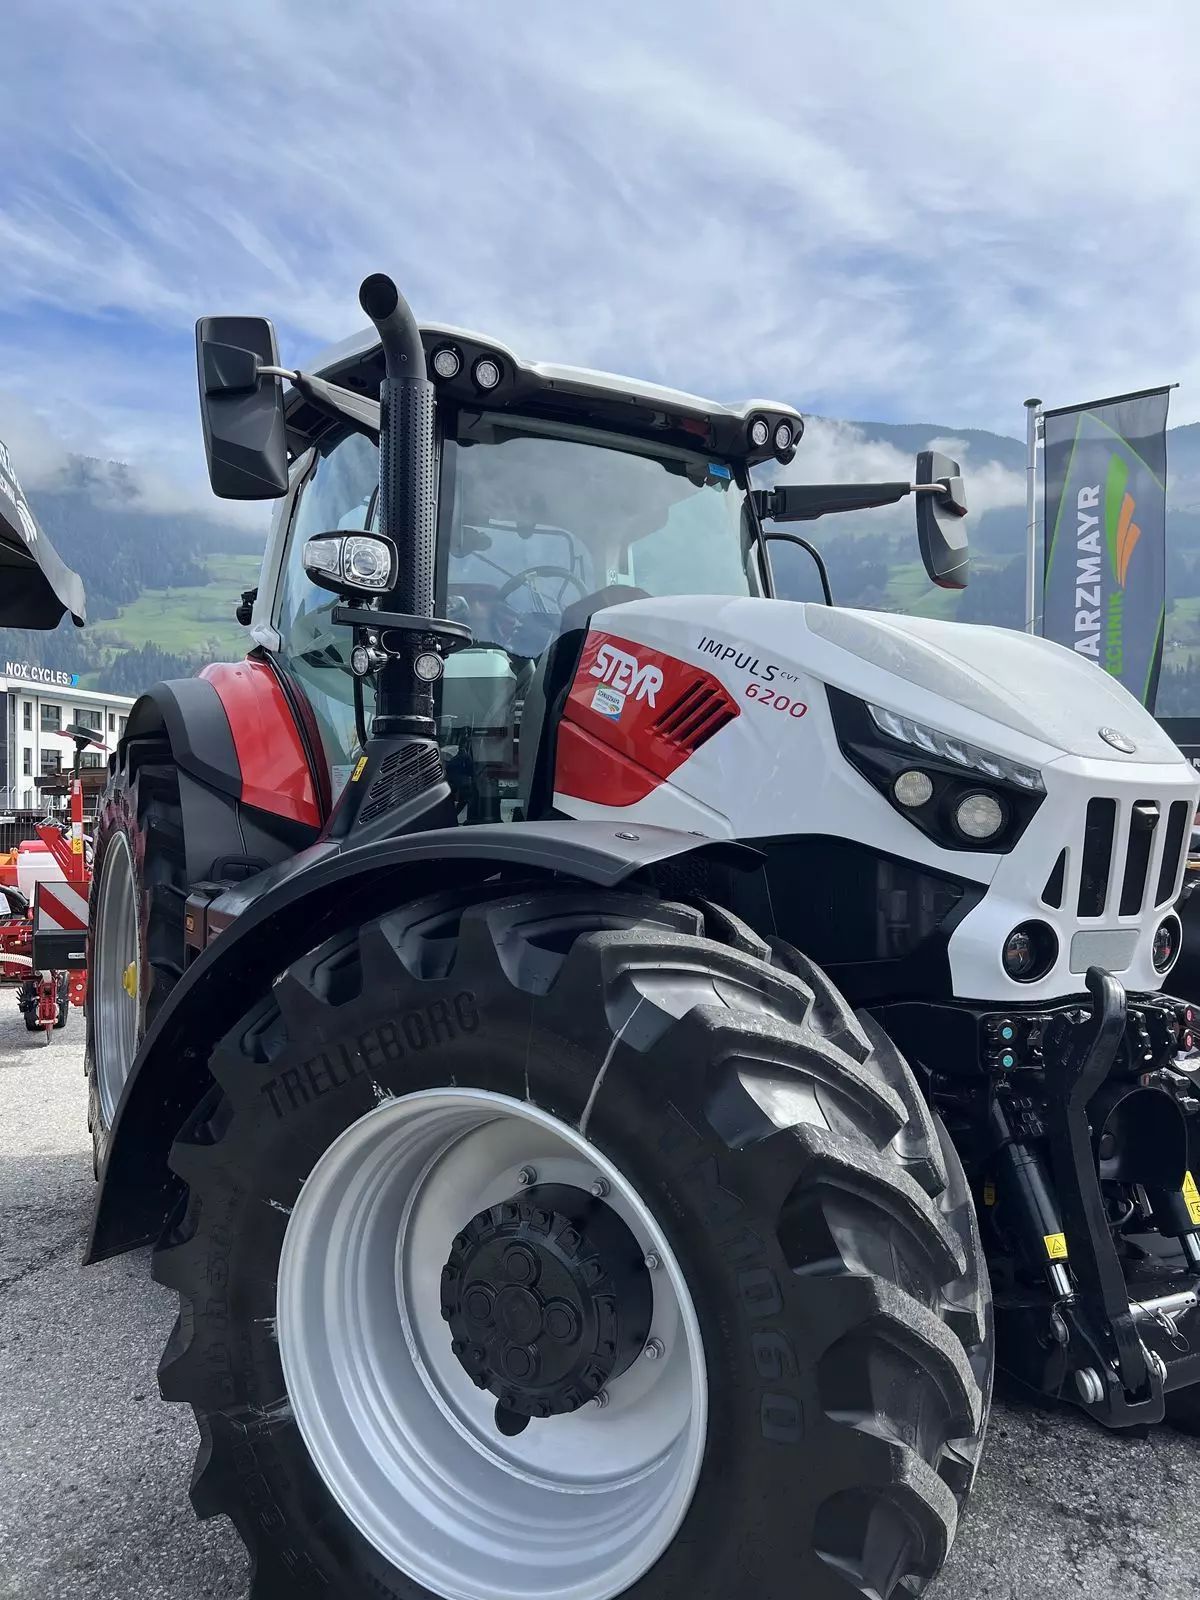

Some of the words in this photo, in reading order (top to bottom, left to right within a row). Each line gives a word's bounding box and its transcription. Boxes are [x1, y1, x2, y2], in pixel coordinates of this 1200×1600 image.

[1074, 485, 1101, 666] ARZMAYR
[6, 661, 27, 678] NOX
[31, 666, 69, 685] CYCLES
[589, 643, 664, 709] STEYR
[698, 636, 779, 682] IMPULS
[780, 671, 800, 683] CVT
[745, 683, 808, 718] 6200
[260, 990, 480, 1119] TRELLEBORG
